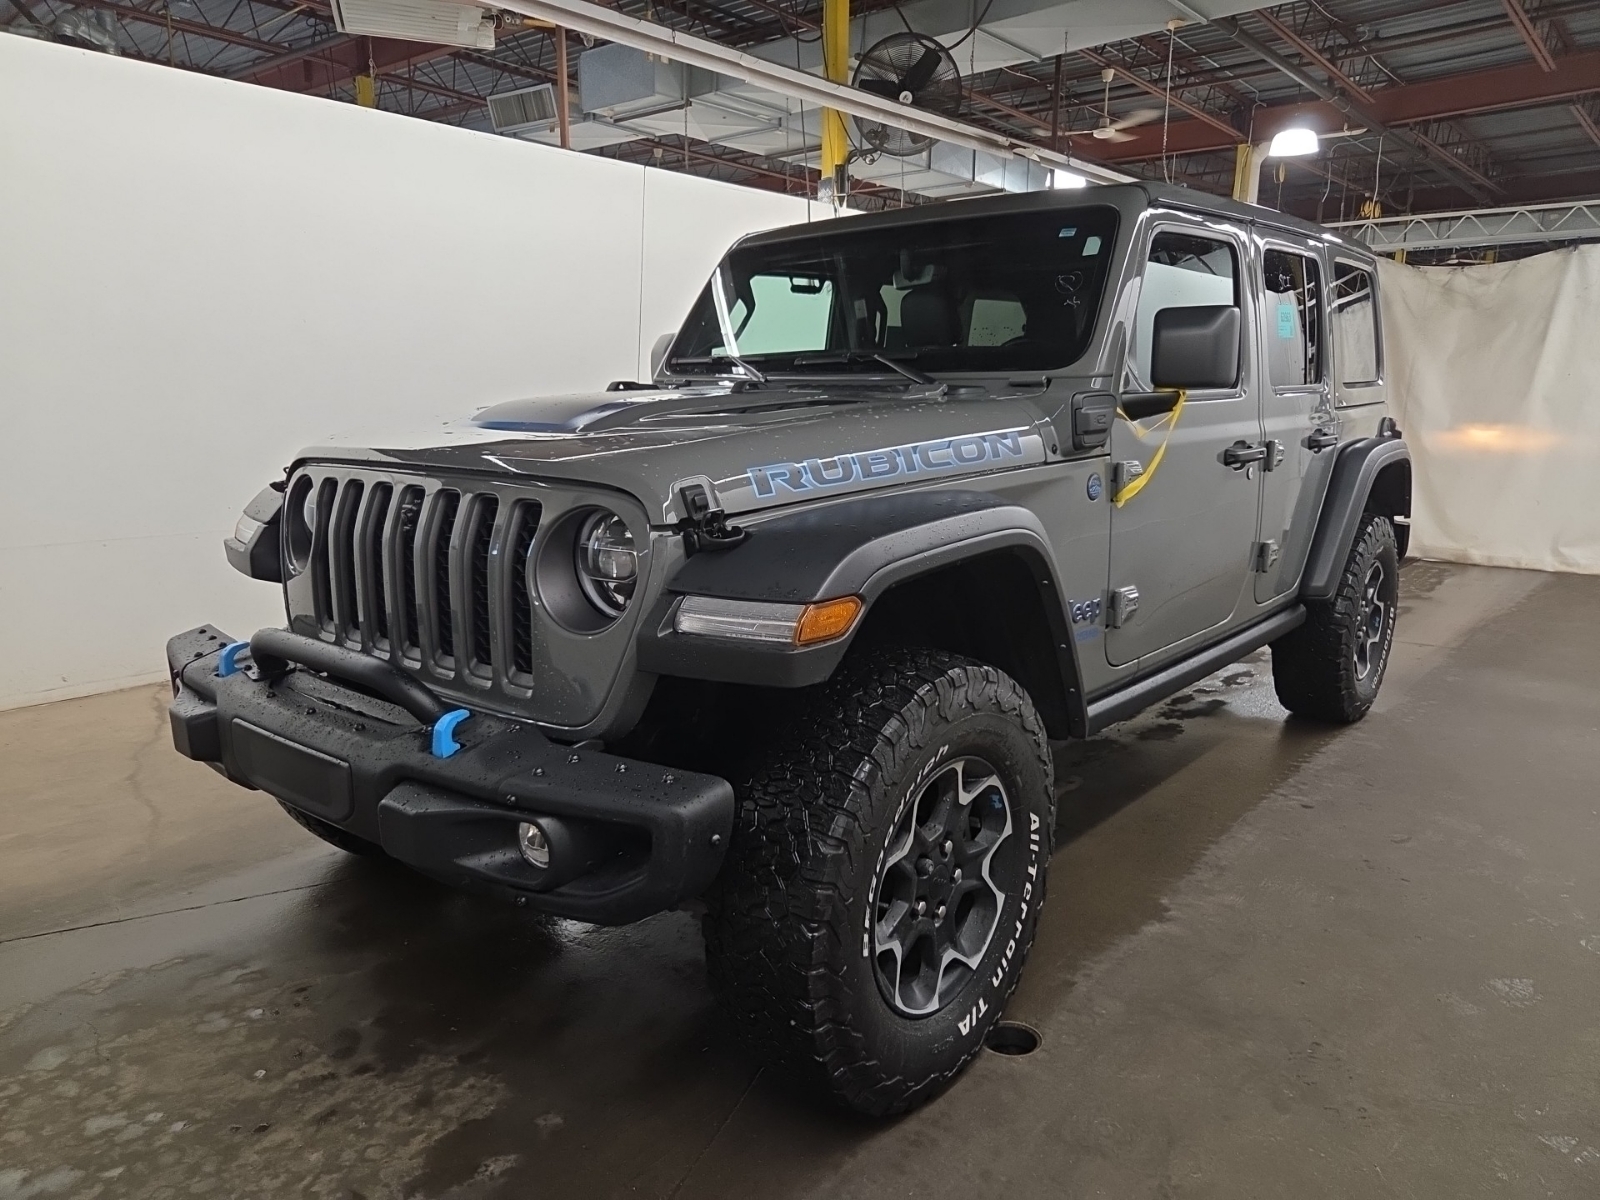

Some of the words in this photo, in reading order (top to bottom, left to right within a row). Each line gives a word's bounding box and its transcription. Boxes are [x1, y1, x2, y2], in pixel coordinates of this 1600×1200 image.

[747, 432, 1024, 498] RUBICON
[991, 811, 1040, 988] All-Terrain
[957, 997, 989, 1037] T/A
